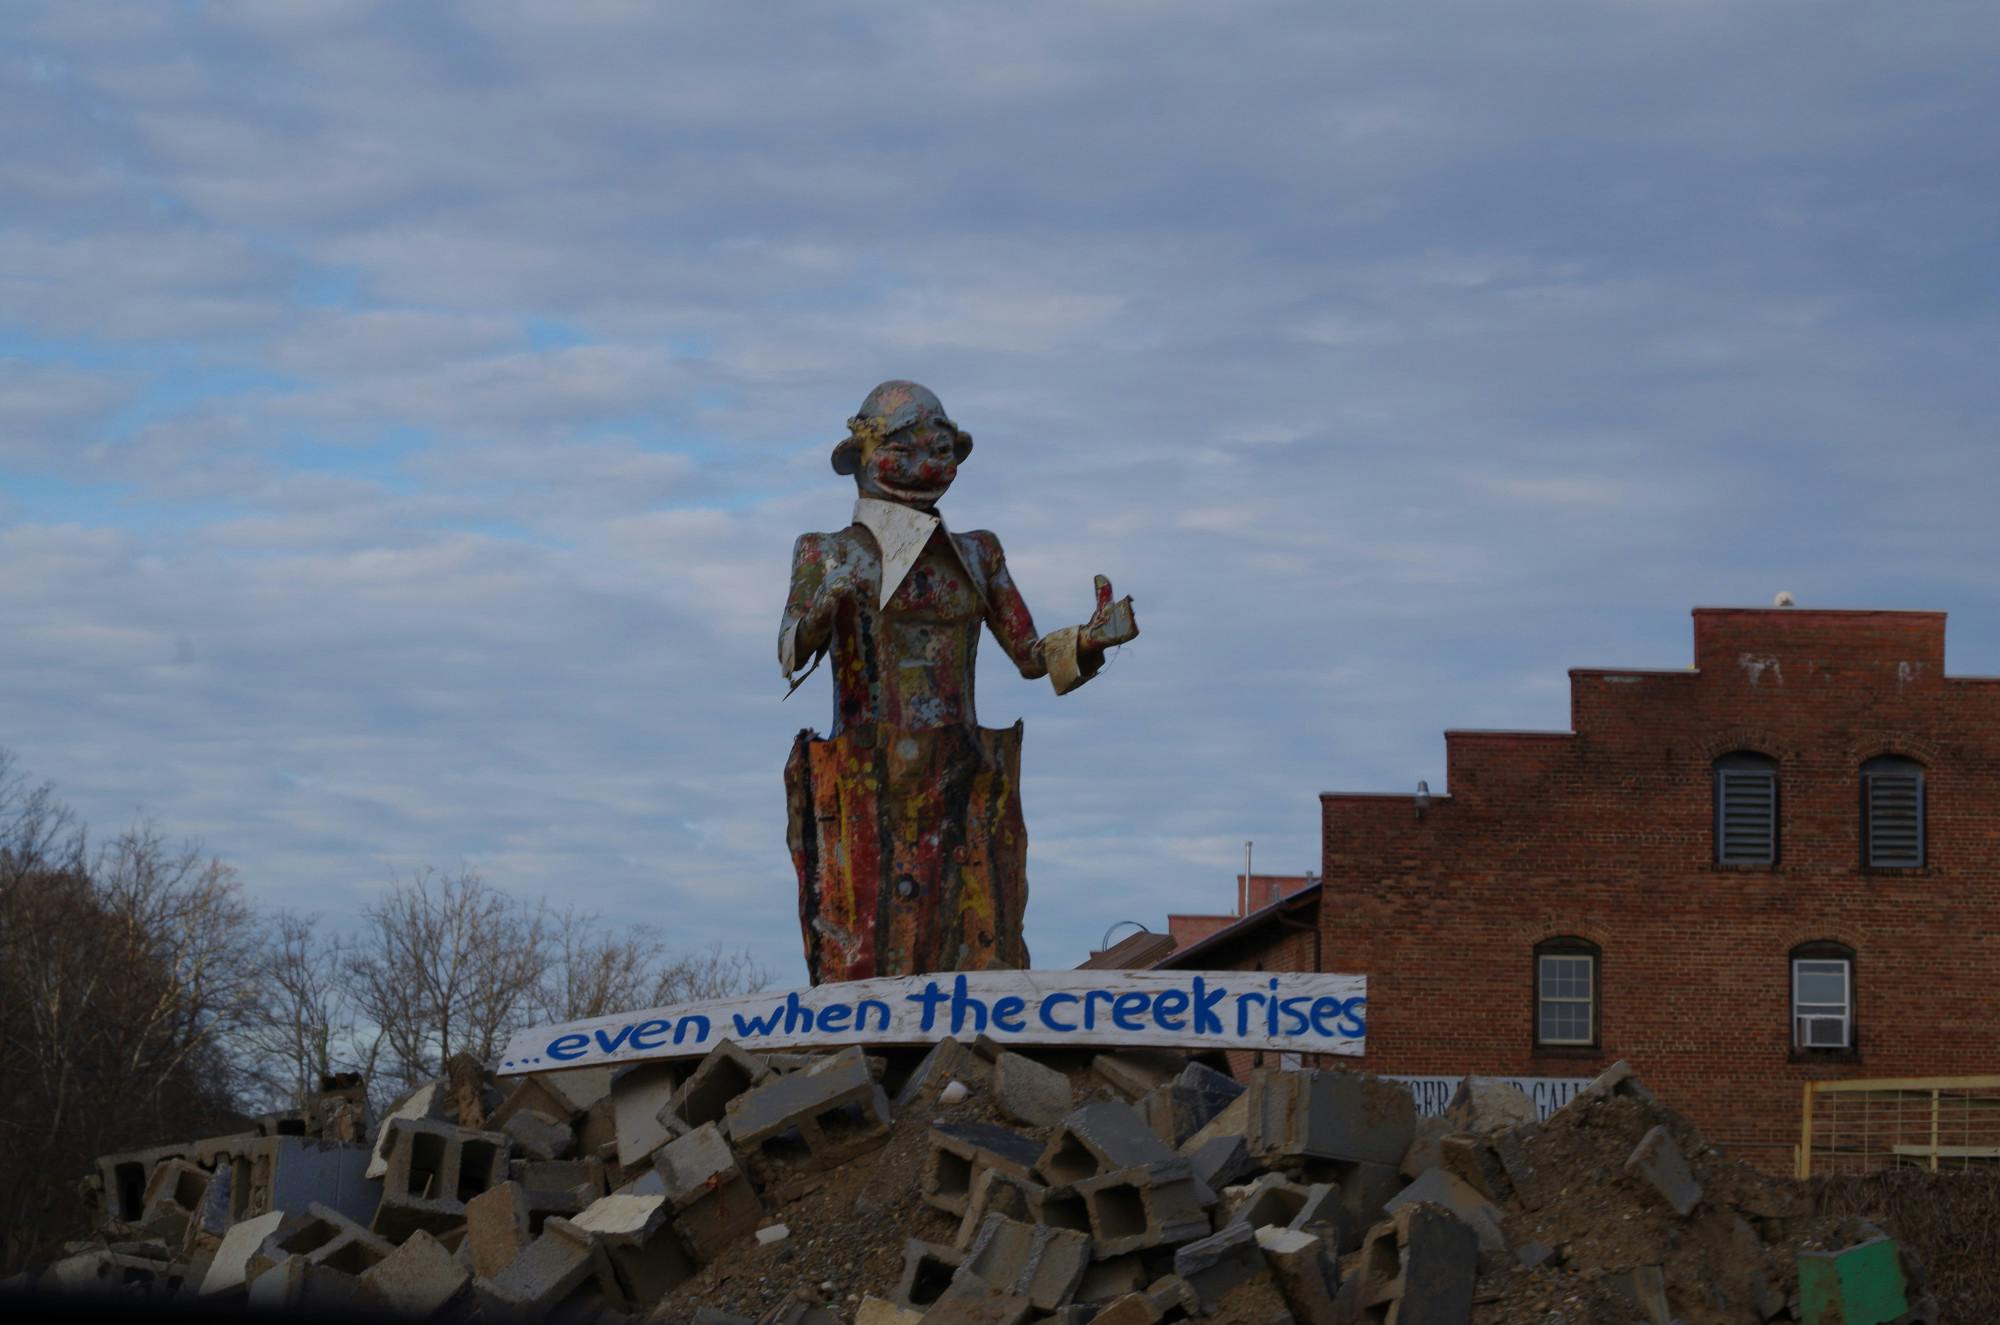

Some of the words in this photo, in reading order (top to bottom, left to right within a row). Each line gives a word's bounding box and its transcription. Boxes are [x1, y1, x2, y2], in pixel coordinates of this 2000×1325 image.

[732, 991, 892, 1039] when
[905, 974, 1026, 1036] the
[1038, 975, 1228, 1035] creek
[1235, 977, 1366, 1039] rises
